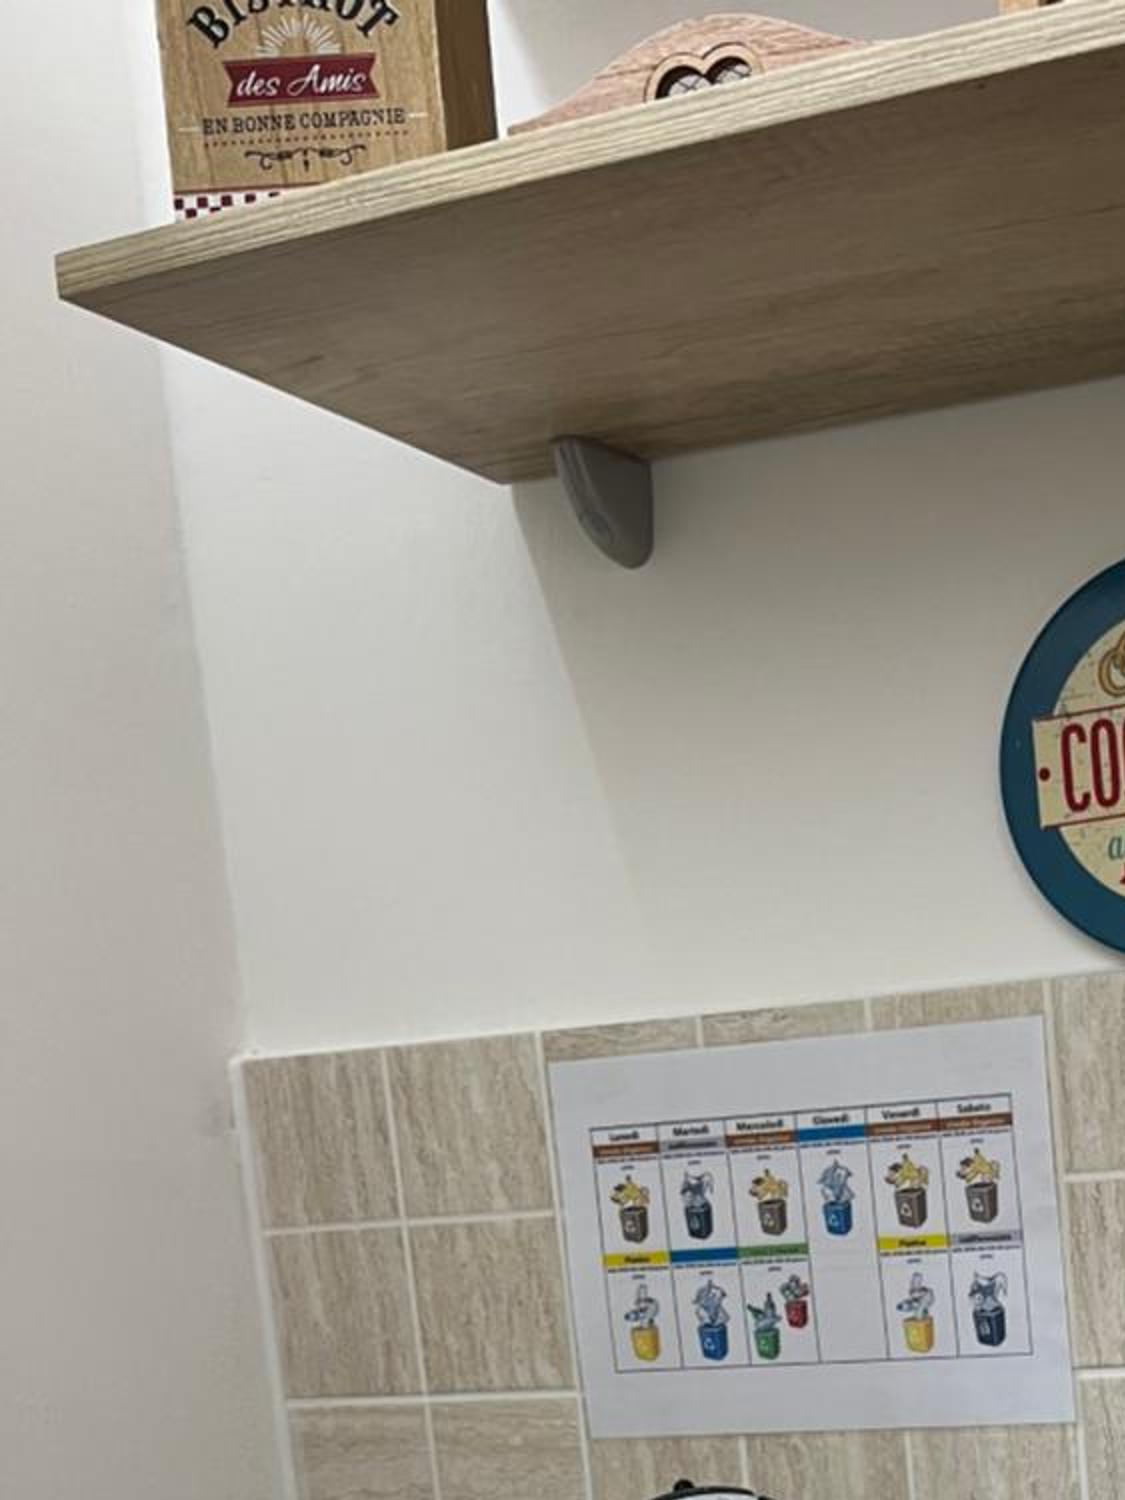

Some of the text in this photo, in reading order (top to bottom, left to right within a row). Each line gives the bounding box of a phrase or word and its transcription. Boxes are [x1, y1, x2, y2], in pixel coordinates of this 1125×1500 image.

[236, 64, 368, 97] des Amis
[202, 107, 406, 135] EN BONNE COMPAGNIE
